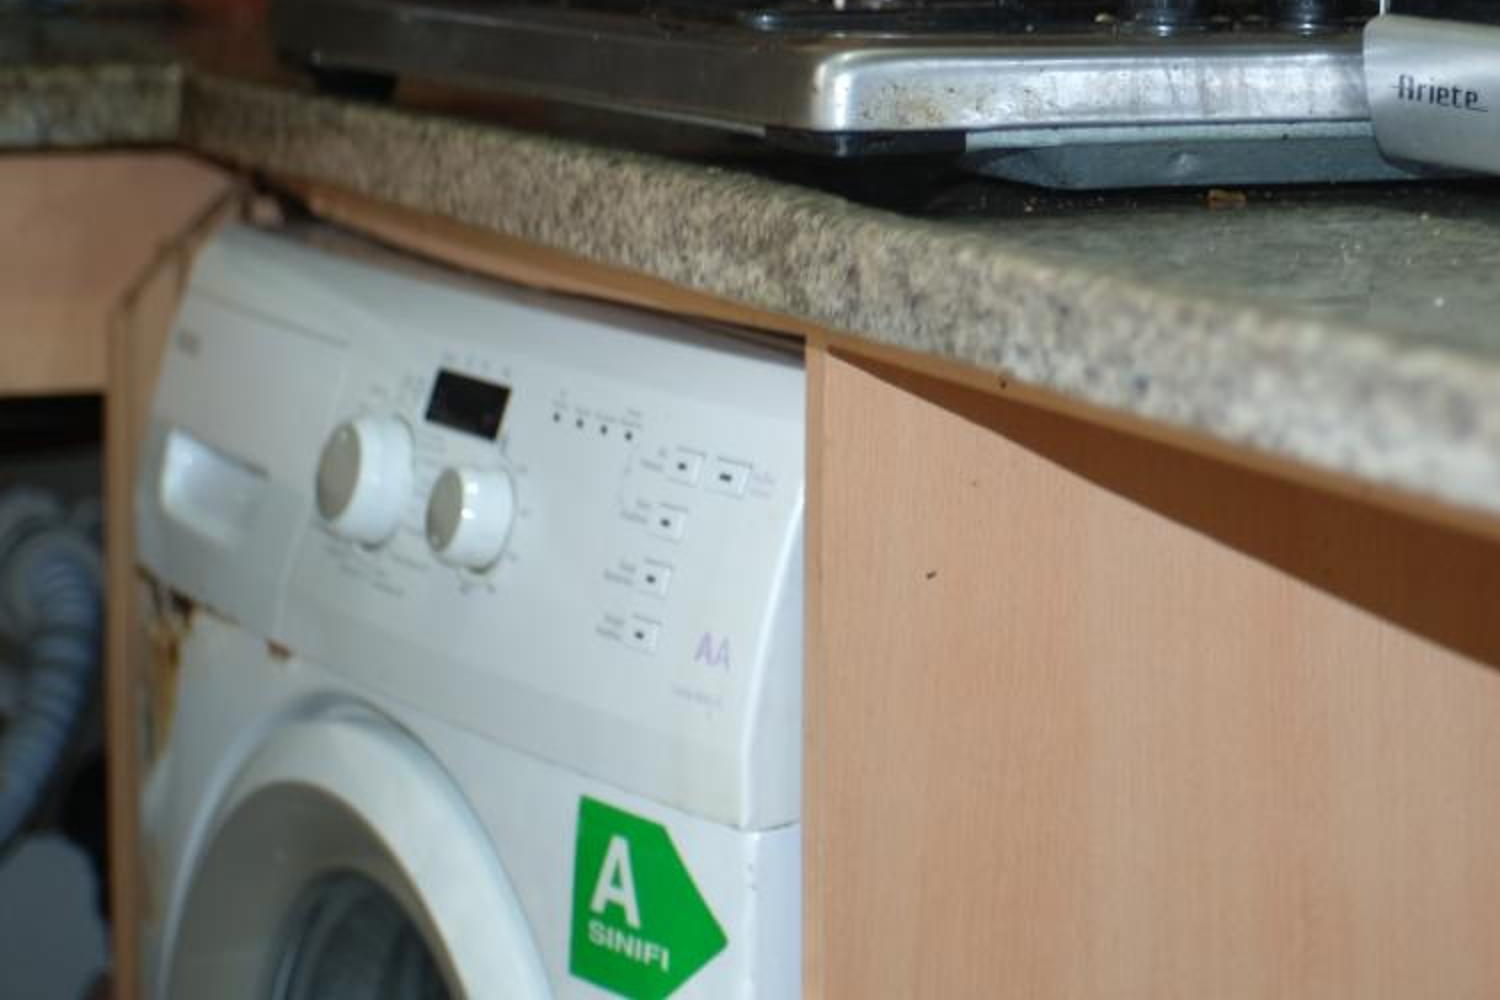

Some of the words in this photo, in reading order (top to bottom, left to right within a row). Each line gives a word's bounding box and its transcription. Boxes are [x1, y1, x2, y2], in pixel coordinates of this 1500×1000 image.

[1395, 74, 1488, 112] Ariete
[590, 834, 642, 931] A
[587, 917, 671, 974] SINIFI
